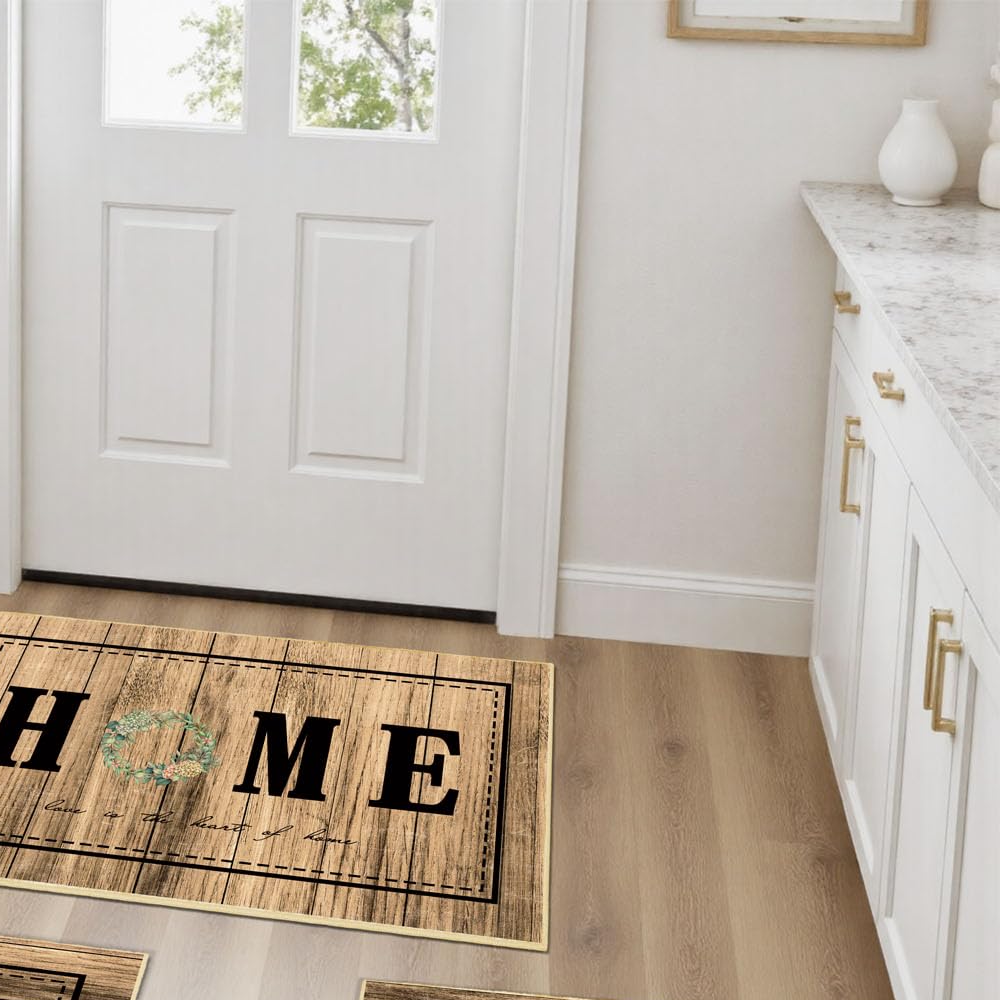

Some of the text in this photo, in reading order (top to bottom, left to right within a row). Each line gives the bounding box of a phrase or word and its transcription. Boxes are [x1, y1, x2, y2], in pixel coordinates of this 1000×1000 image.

[44, 799, 359, 846] love is the heart of home
